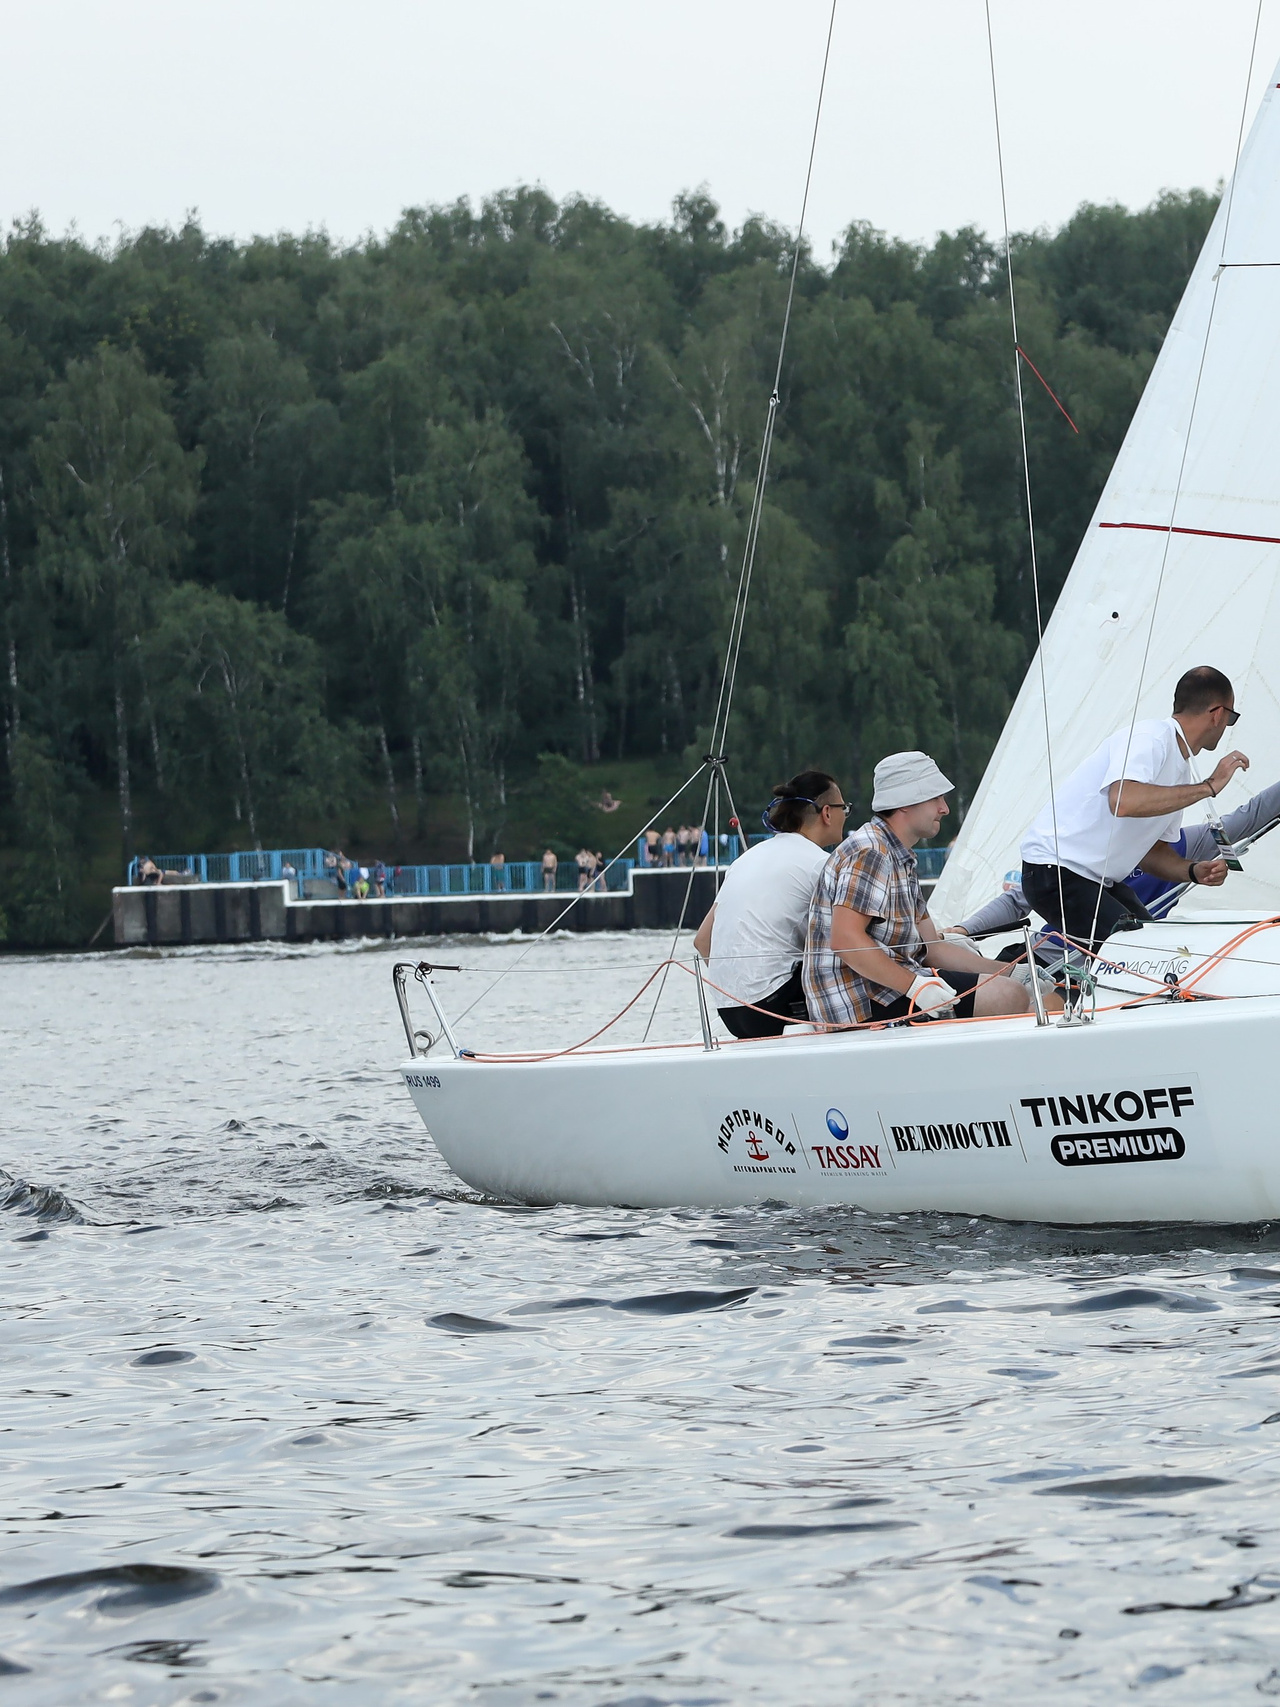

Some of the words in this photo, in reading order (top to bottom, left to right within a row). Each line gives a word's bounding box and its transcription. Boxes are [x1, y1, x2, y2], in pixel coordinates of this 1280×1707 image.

[1095, 960, 1190, 975] PROYACHTING
[405, 1075, 423, 1088] RUS
[423, 1075, 441, 1088] 1499
[1020, 1086, 1194, 1128] TINKOFF
[717, 1109, 797, 1155] МОРПРИБОР
[890, 1121, 1013, 1154] ВЕДОМОСТИ
[811, 1145, 882, 1169] TASSAY
[1058, 1133, 1177, 1160] PREMIUM
